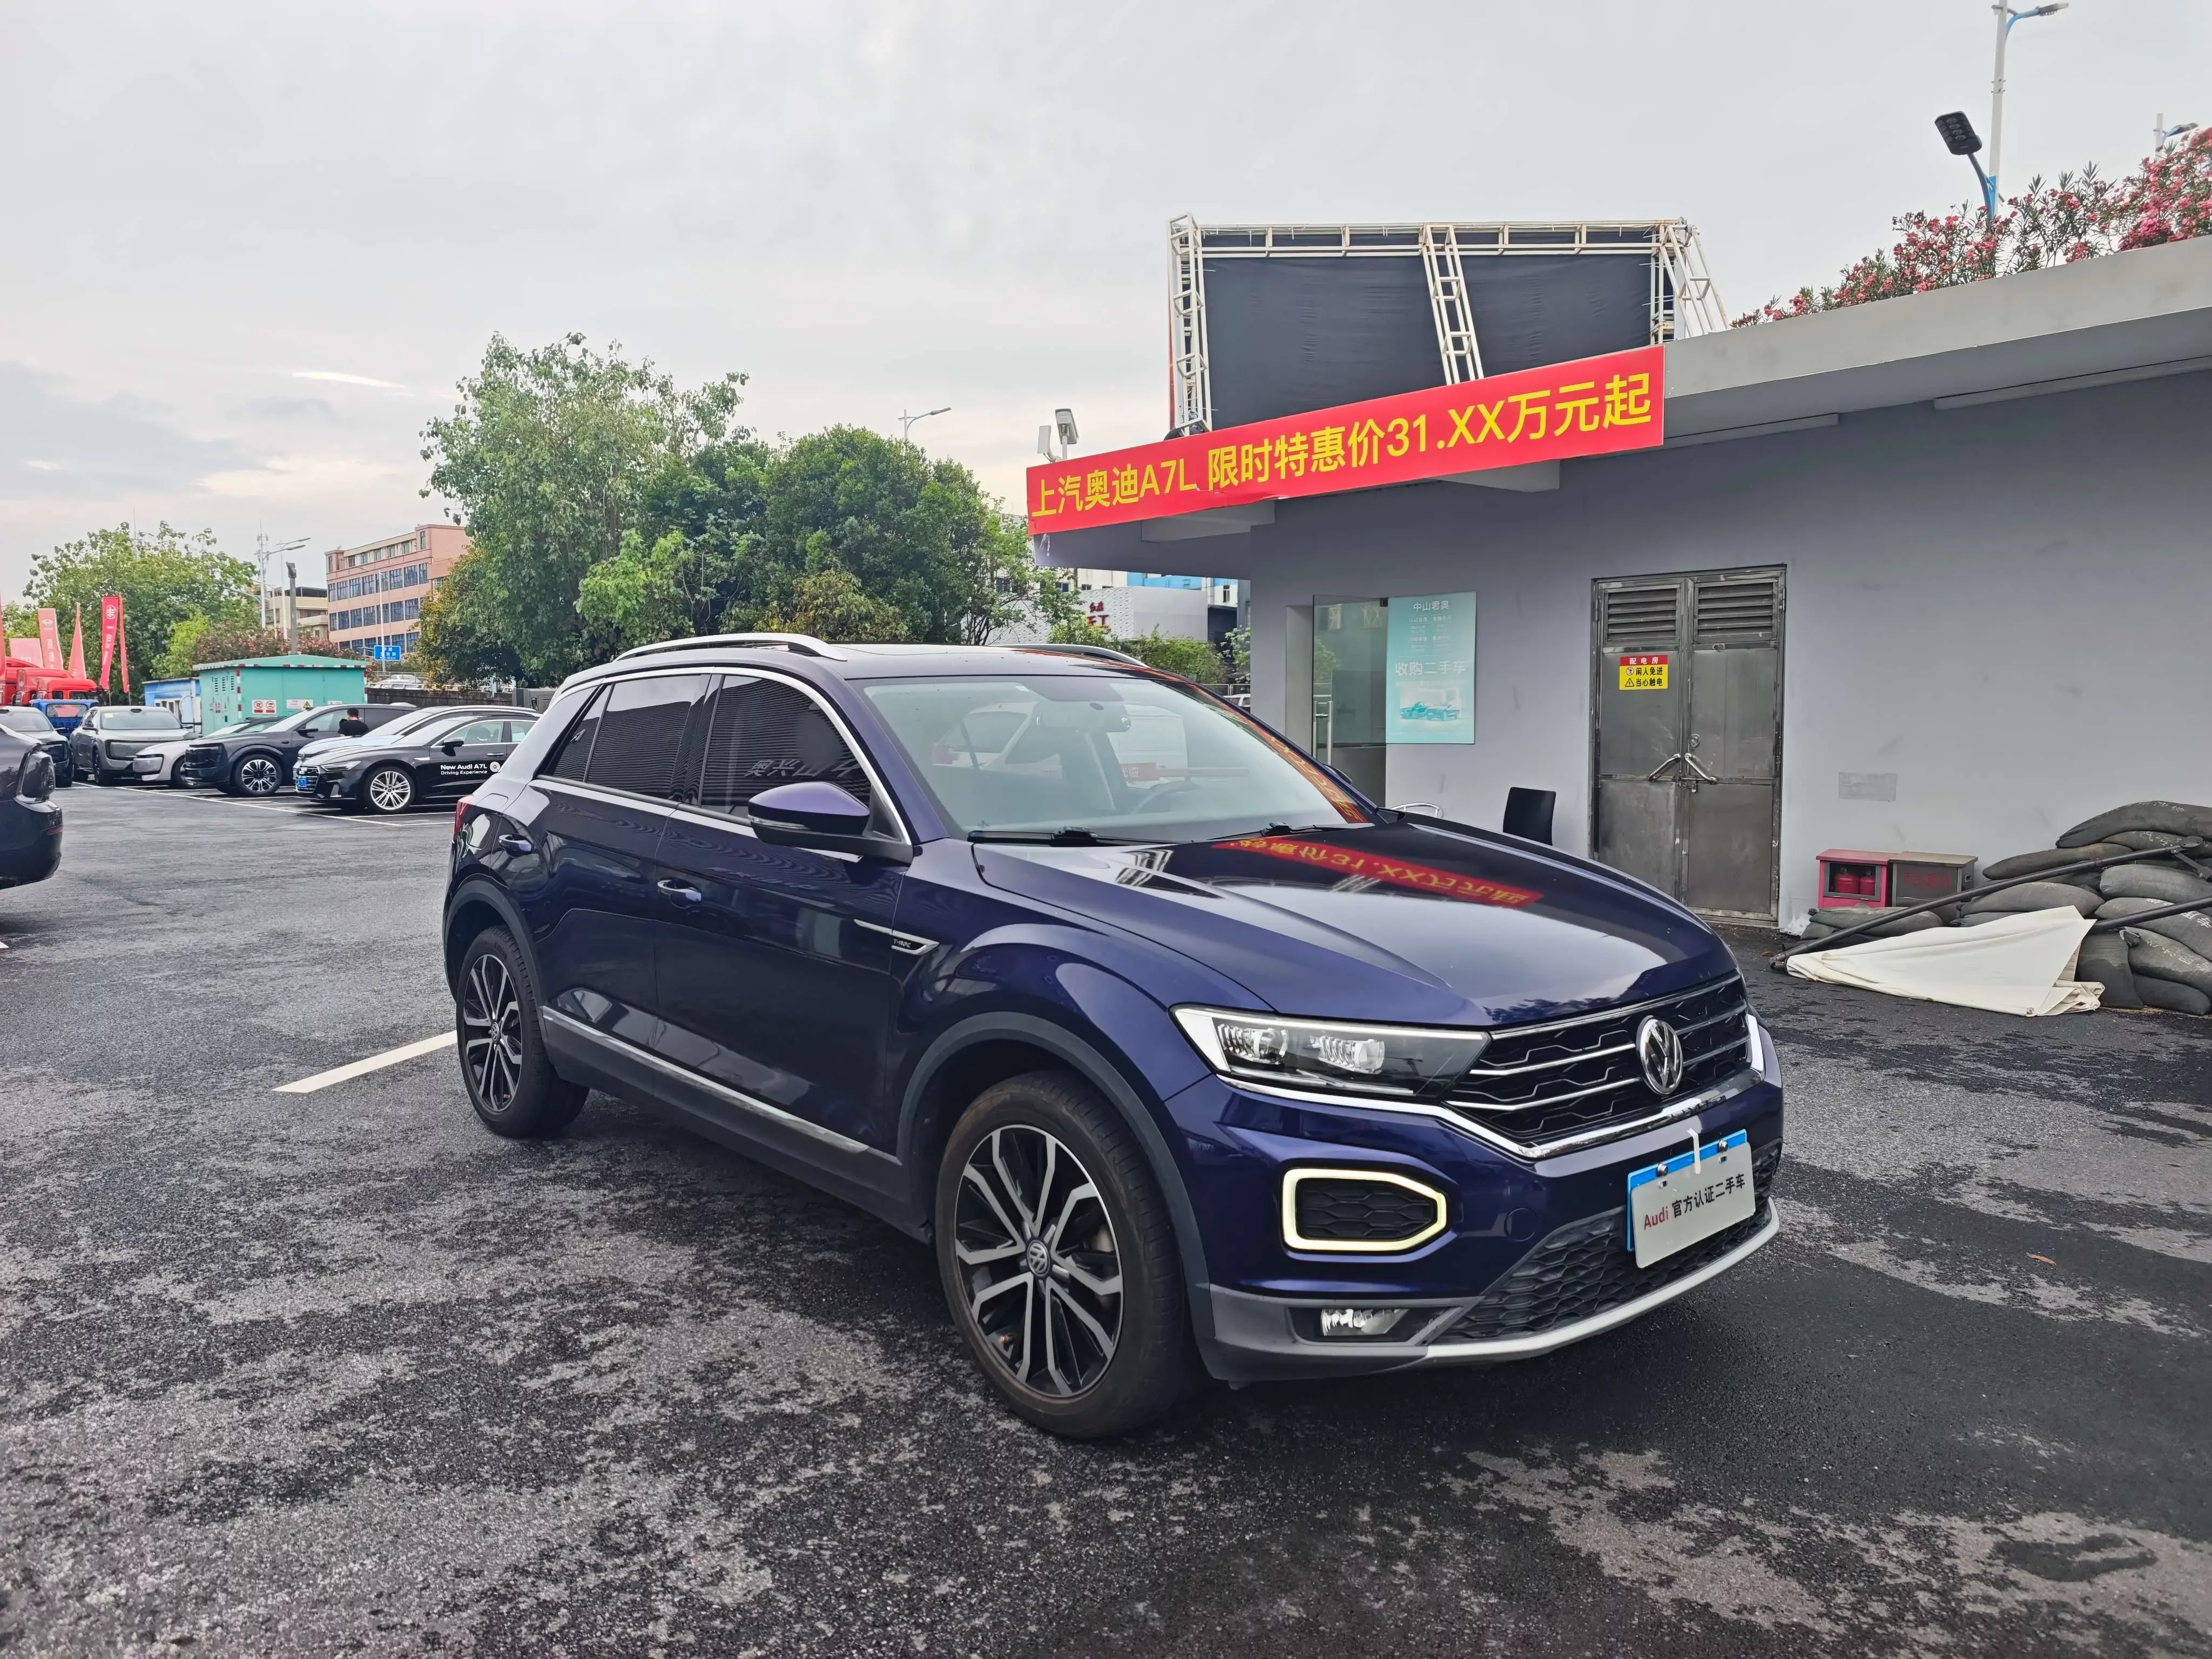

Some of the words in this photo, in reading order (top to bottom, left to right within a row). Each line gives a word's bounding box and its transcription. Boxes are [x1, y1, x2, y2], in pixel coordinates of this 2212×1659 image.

[1031, 461, 1196, 517] 上汽奥迪A7L
[1208, 373, 1652, 492] 限时特惠价31.XX万元起
[1629, 657, 1658, 665] 配电房
[1395, 660, 1466, 676] 收购二手车
[1636, 666, 1663, 676] 闲人免进
[1636, 678, 1663, 686] 当心触电
[1644, 1206, 1669, 1230] Audi
[1672, 1174, 1745, 1218] 官方认证二手车
